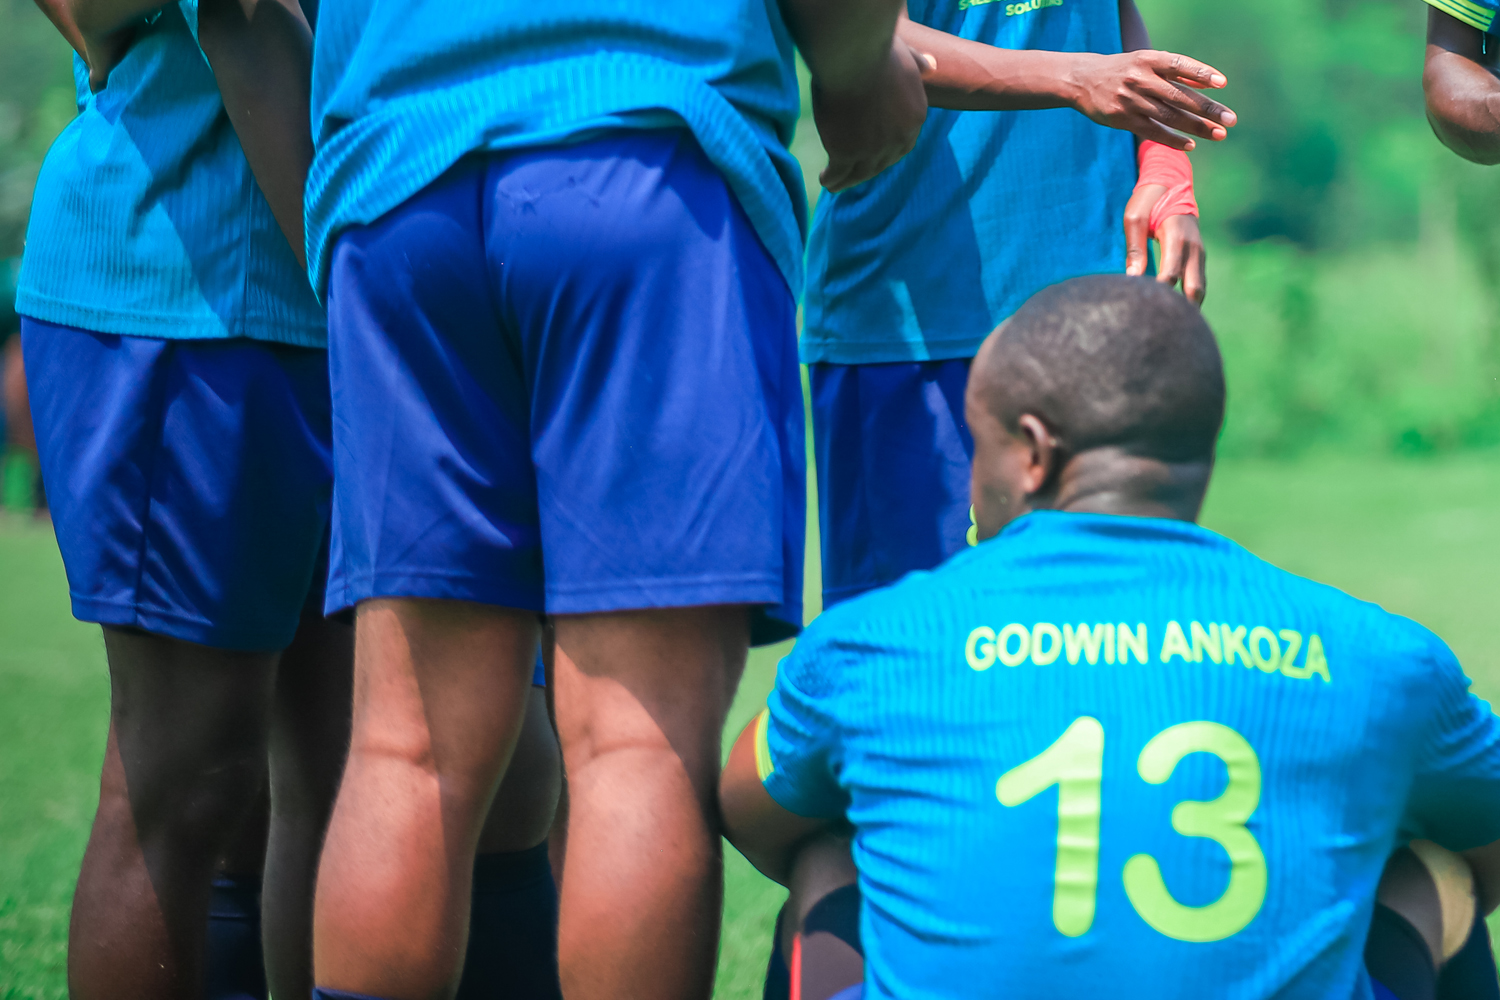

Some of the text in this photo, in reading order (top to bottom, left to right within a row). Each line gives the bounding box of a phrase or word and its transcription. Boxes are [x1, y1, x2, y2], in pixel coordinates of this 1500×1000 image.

[964, 620, 1331, 683] GODWIN ANKOZA
[995, 715, 1268, 943] 13
